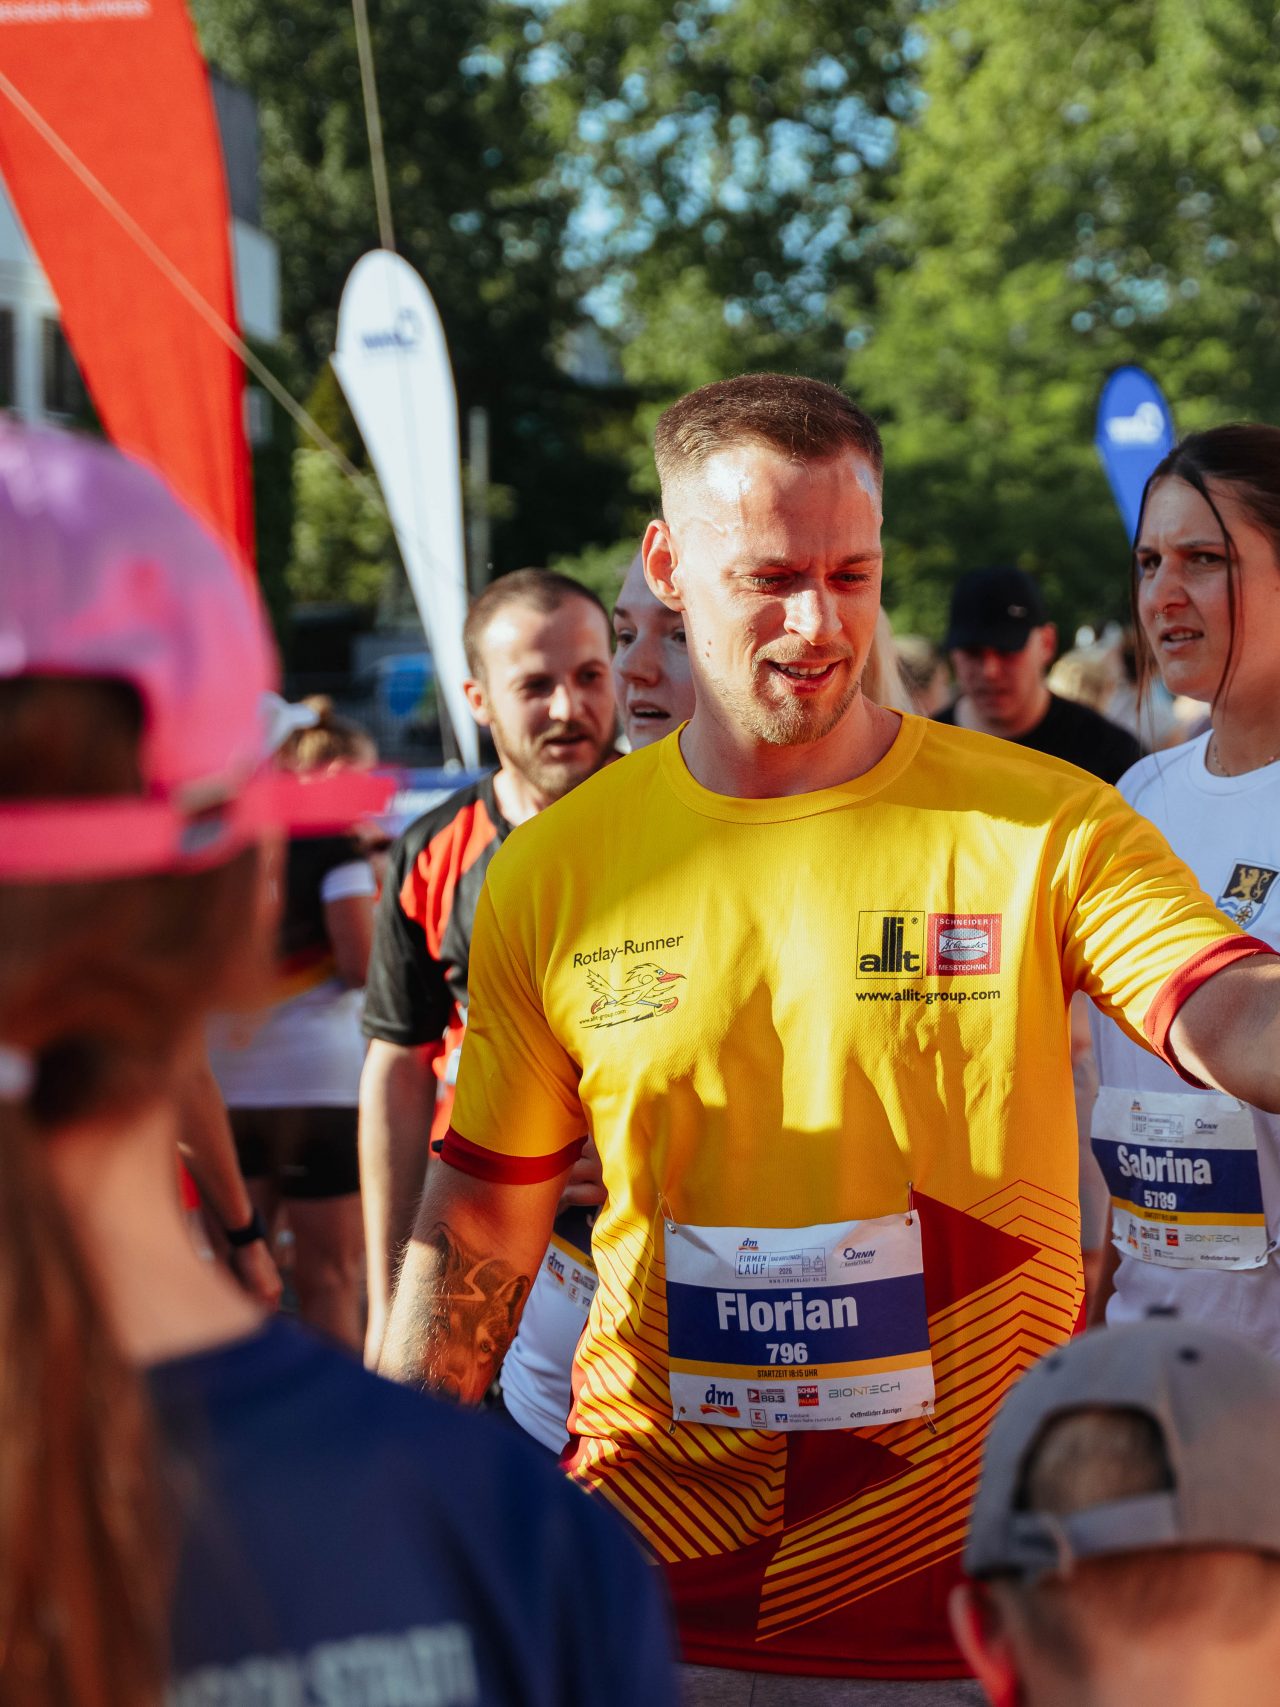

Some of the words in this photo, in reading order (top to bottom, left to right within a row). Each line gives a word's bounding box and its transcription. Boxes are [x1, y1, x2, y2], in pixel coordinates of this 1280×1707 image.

[573, 935, 684, 969] Rotlay-Runner
[859, 917, 920, 972] allit
[855, 989, 1001, 1004] www.allit-group.com
[1116, 1144, 1213, 1185] Sabrina
[1144, 1189, 1177, 1211] 5789
[742, 1238, 758, 1247] dm
[1185, 1234, 1240, 1243] BIONTECH
[548, 1252, 565, 1275] dm
[739, 1254, 767, 1262] FIRMEN
[738, 1263, 766, 1275] LAUF
[716, 1292, 859, 1332] Florian
[766, 1343, 808, 1364] 796
[757, 1369, 787, 1378] STARTZEIT
[804, 1368, 818, 1377] UHR
[705, 1384, 734, 1406] dm
[761, 1393, 785, 1403] 88.3
[828, 1381, 901, 1399] BIONTECH
